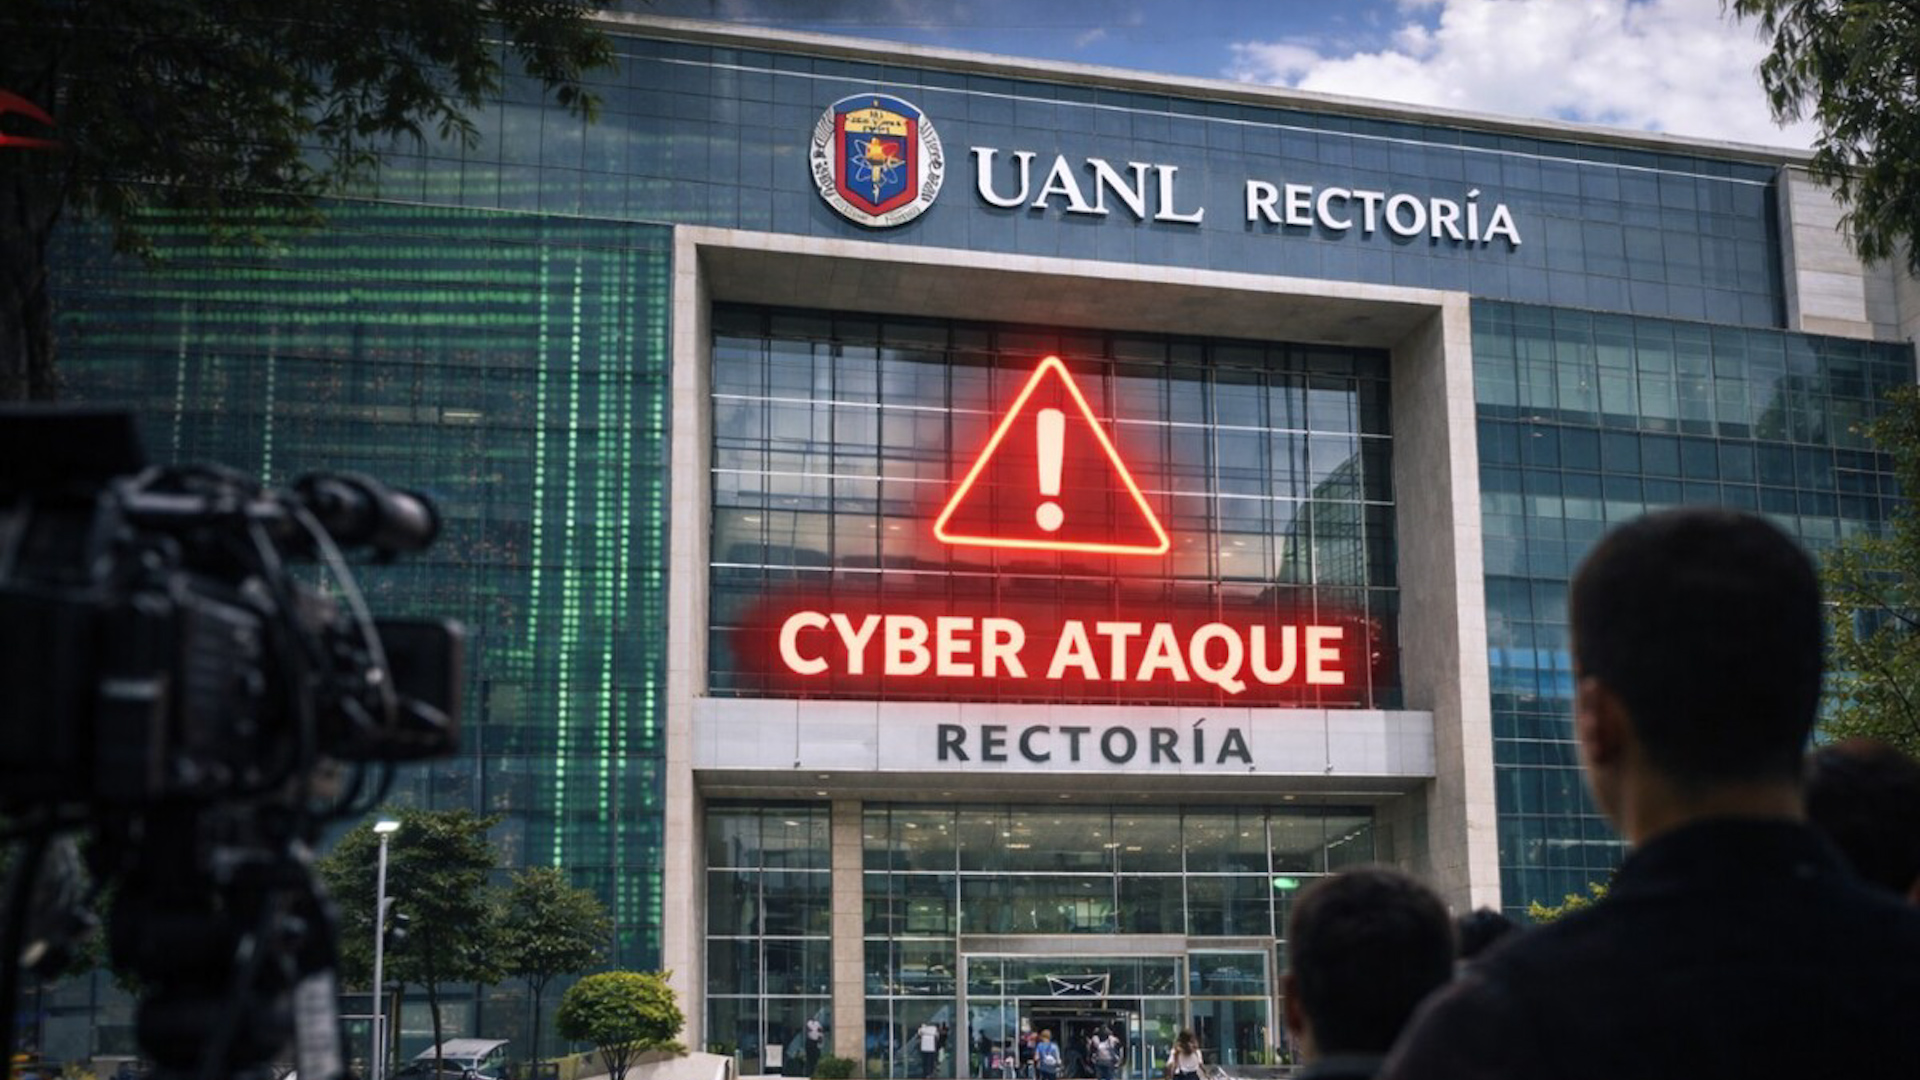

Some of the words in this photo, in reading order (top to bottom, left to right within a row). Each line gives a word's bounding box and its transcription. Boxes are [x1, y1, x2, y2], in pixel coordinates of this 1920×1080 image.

[970, 146, 1205, 225] UANL
[1245, 179, 1522, 246] RECTORÍA
[778, 610, 1028, 679] CYBER
[1045, 620, 1345, 695] ATAQUE
[937, 717, 1254, 766] RECTORÍA
